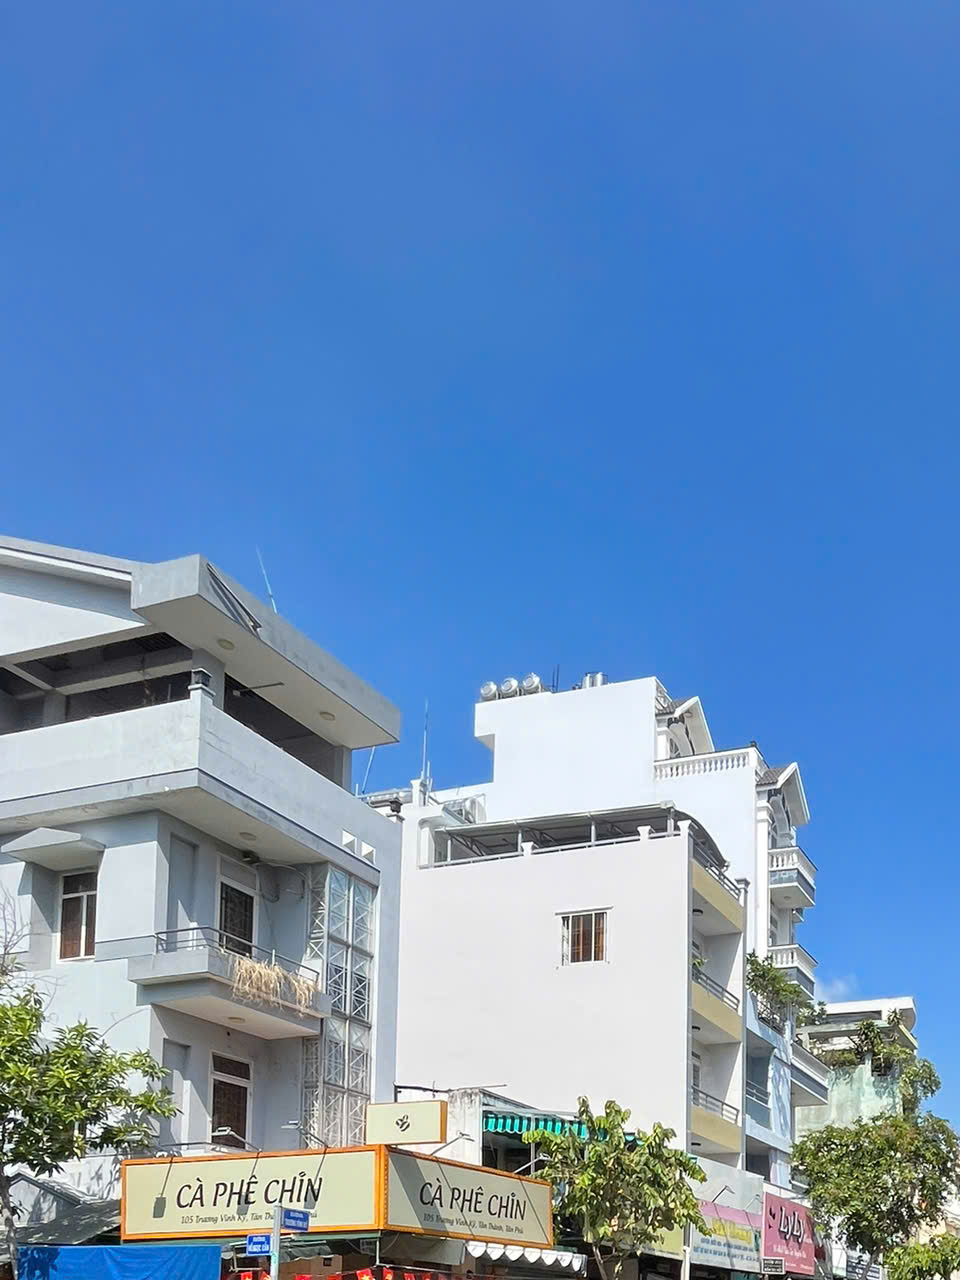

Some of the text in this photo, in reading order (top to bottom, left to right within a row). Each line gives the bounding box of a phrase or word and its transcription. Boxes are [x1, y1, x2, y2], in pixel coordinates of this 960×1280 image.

[176, 1177, 205, 1208] CÀ
[212, 1175, 259, 1208] PHÊ
[419, 1178, 444, 1208] CÀ
[450, 1186, 484, 1213] PHÊ
